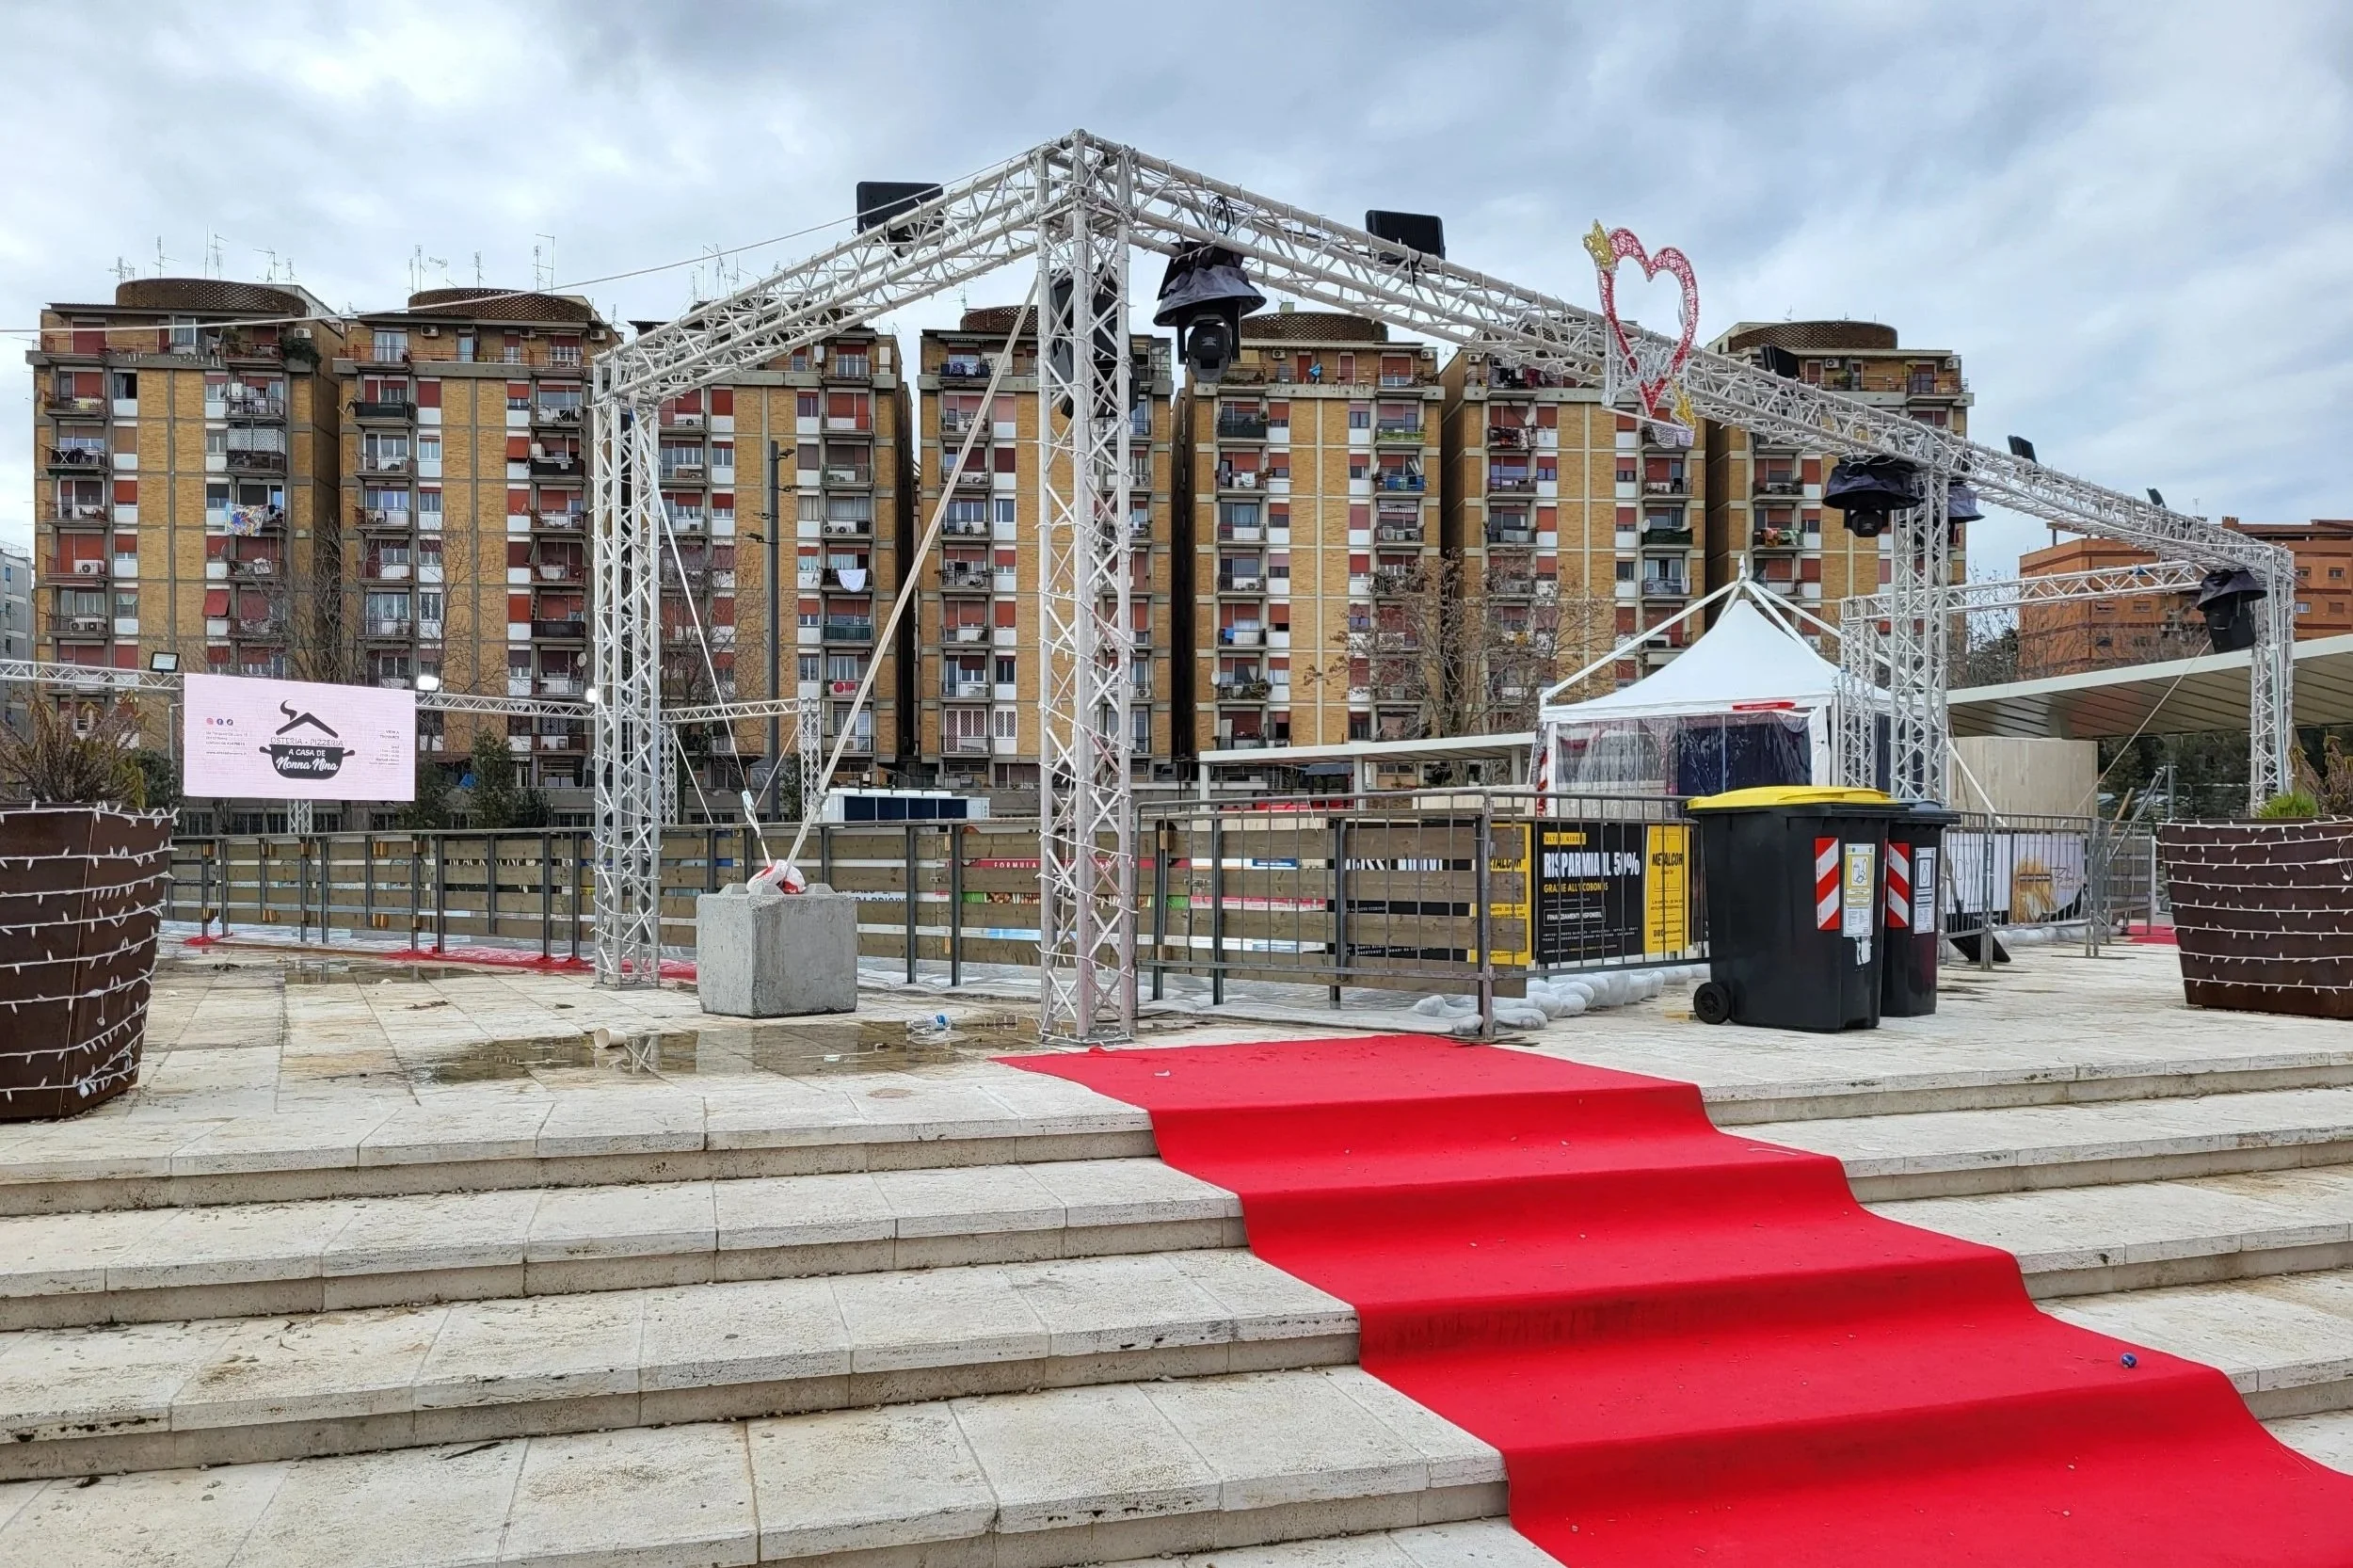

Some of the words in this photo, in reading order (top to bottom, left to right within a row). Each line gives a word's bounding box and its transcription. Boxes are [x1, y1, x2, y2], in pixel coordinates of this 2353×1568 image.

[270, 737, 303, 745] OSTERIA
[310, 739, 344, 747] PIZZERIA
[316, 749, 327, 758] DE
[276, 756, 312, 771] Nonna
[312, 758, 339, 772] Nina
[1544, 852, 1600, 877] RISPARMIA
[1602, 852, 1611, 876] IL
[1613, 852, 1641, 876] 50%
[1544, 883, 1567, 894] GRAIE
